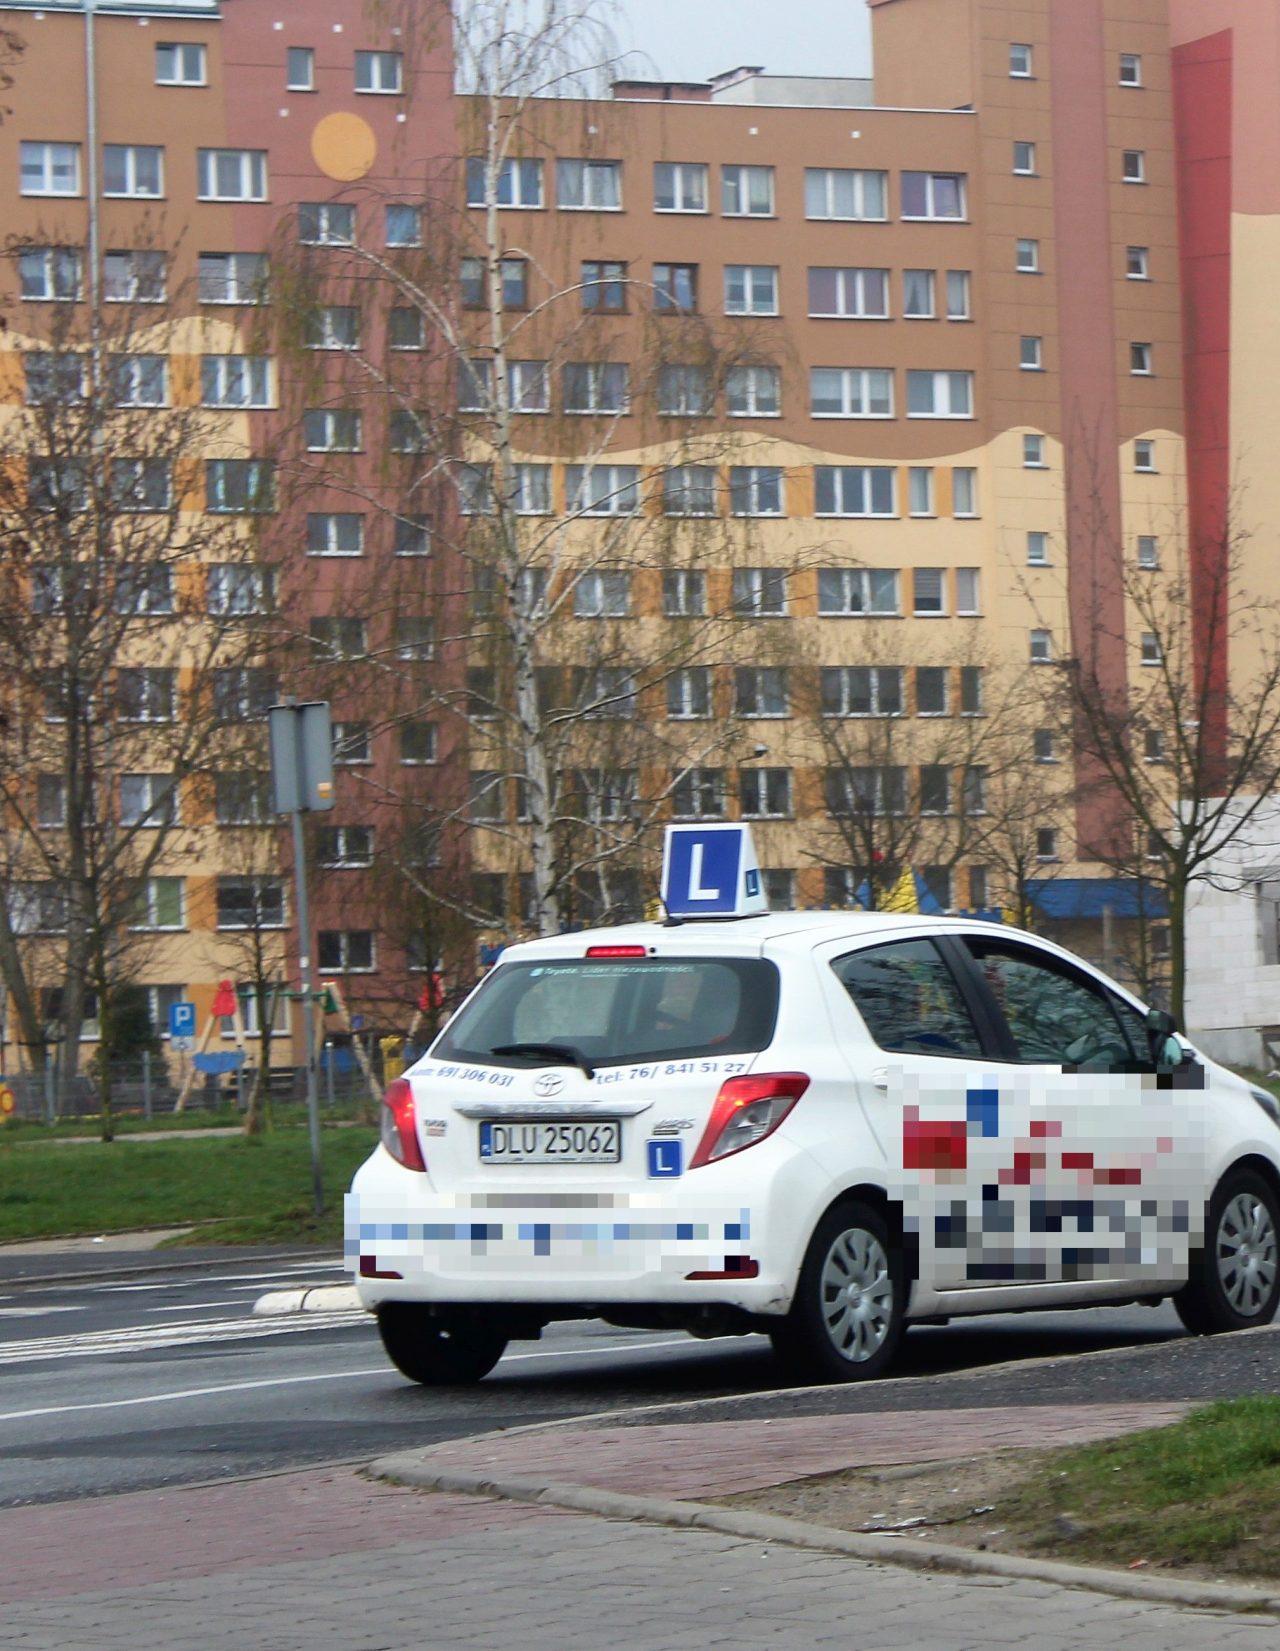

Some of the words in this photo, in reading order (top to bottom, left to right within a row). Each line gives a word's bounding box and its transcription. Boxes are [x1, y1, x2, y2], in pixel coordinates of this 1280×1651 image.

[688, 843, 720, 900] L
[175, 1006, 190, 1027] P
[436, 1066, 458, 1077] 691
[459, 1068, 486, 1082] 306
[489, 1073, 515, 1087] 031
[665, 1063, 694, 1075] 841
[699, 1063, 717, 1072] 51
[724, 1063, 745, 1073] 27
[493, 1126, 537, 1154] DLU
[545, 1126, 615, 1154] 25062
[656, 1147, 673, 1171] L
